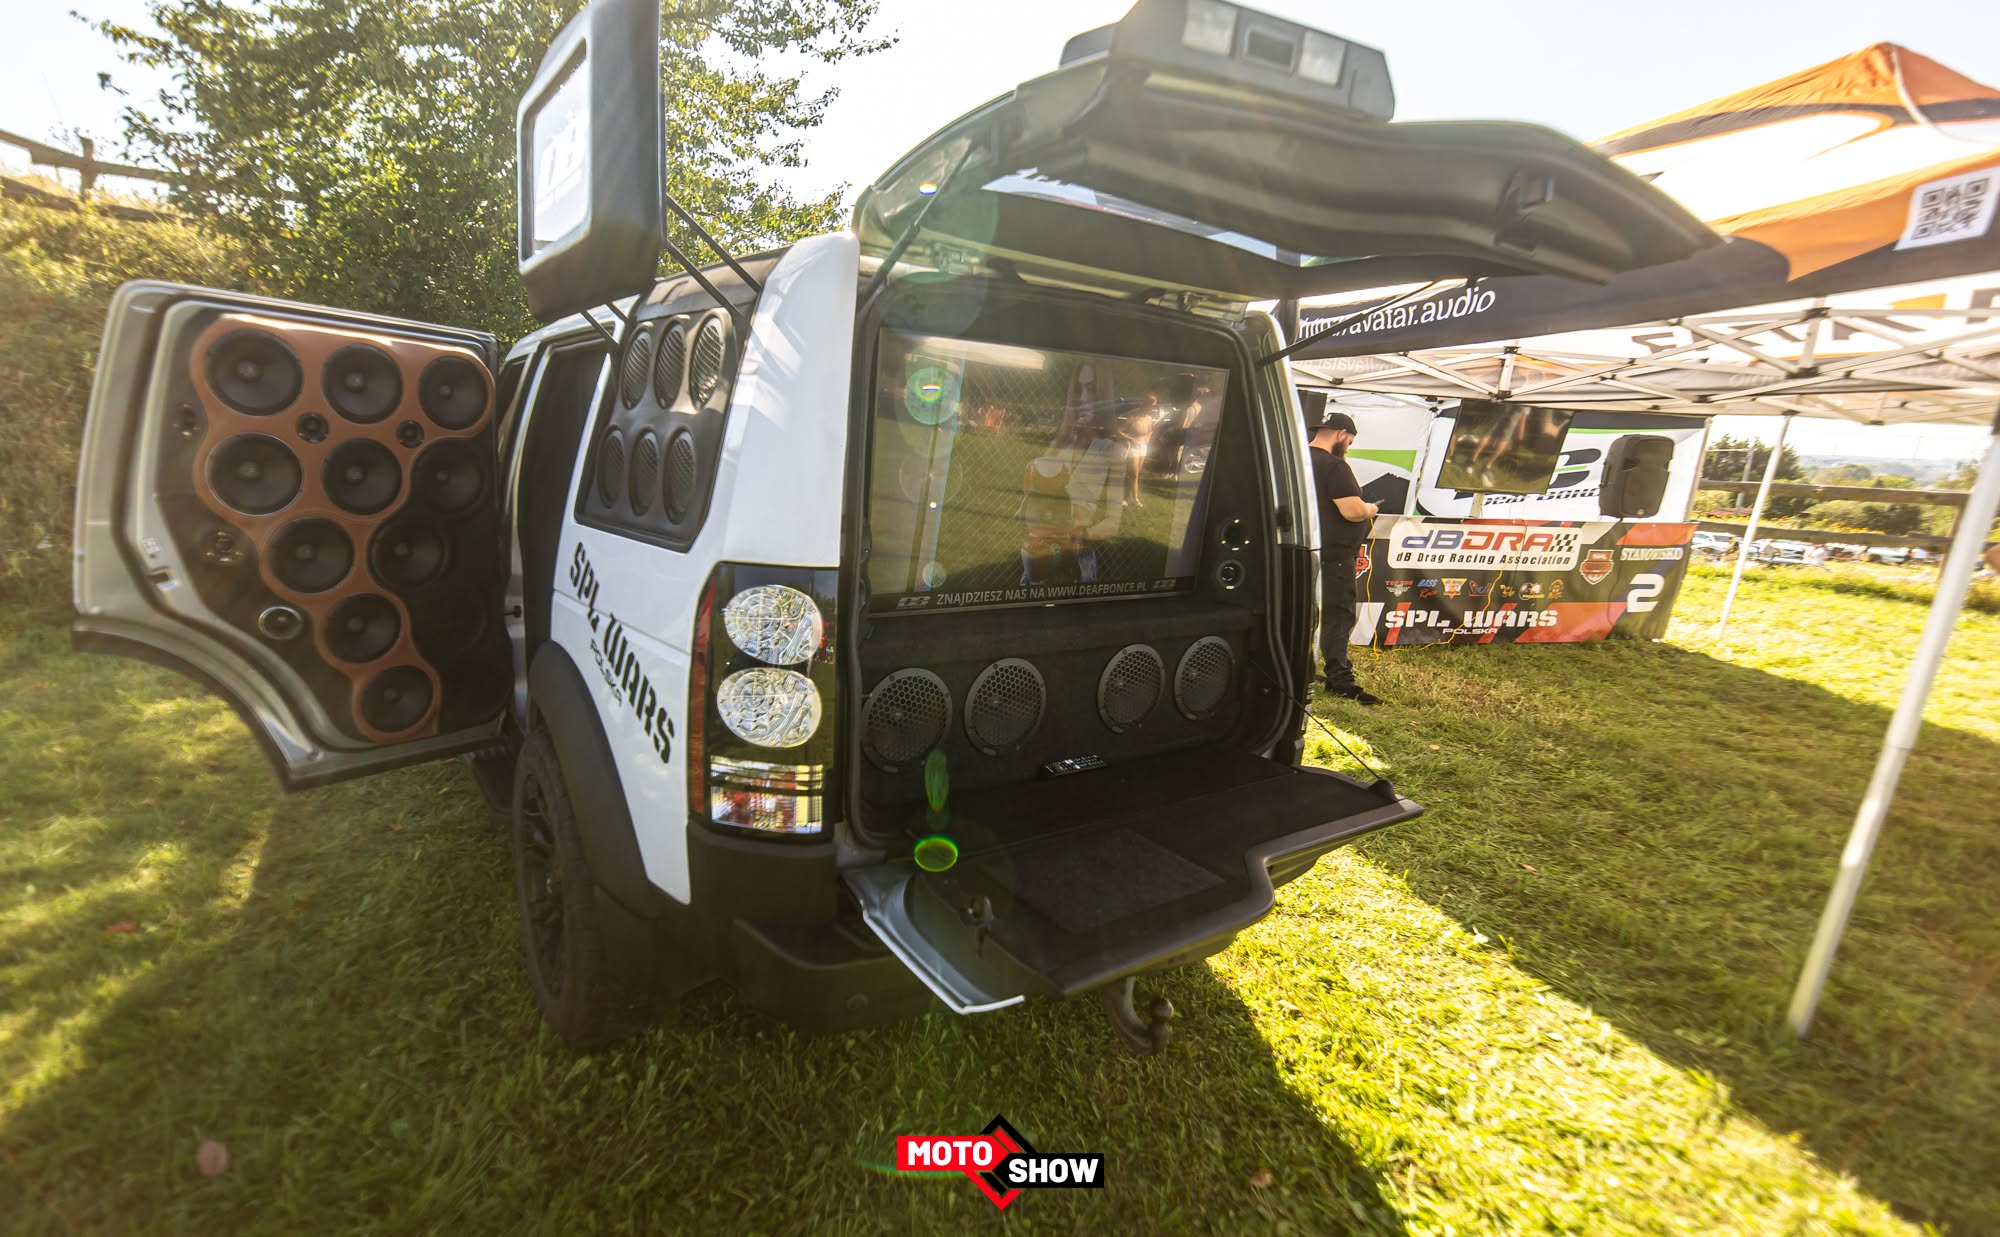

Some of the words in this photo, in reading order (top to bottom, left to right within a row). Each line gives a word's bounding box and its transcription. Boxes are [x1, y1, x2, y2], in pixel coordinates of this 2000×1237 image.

[1396, 552, 1411, 562] dB
[1417, 553, 1444, 564] Drag
[1450, 554, 1495, 565] Racing
[1499, 555, 1571, 565] Association
[936, 590, 1002, 606] ZNAJDZIESZ
[1005, 588, 1027, 600] NAS
[1029, 586, 1045, 598] NA
[1047, 581, 1148, 597] WWW.DEAFBONCE.PL
[1626, 573, 1664, 613] 2
[1384, 609, 1451, 628] SPL
[1463, 610, 1559, 628] WARS
[570, 541, 599, 633] SPL
[604, 612, 674, 764] WARS
